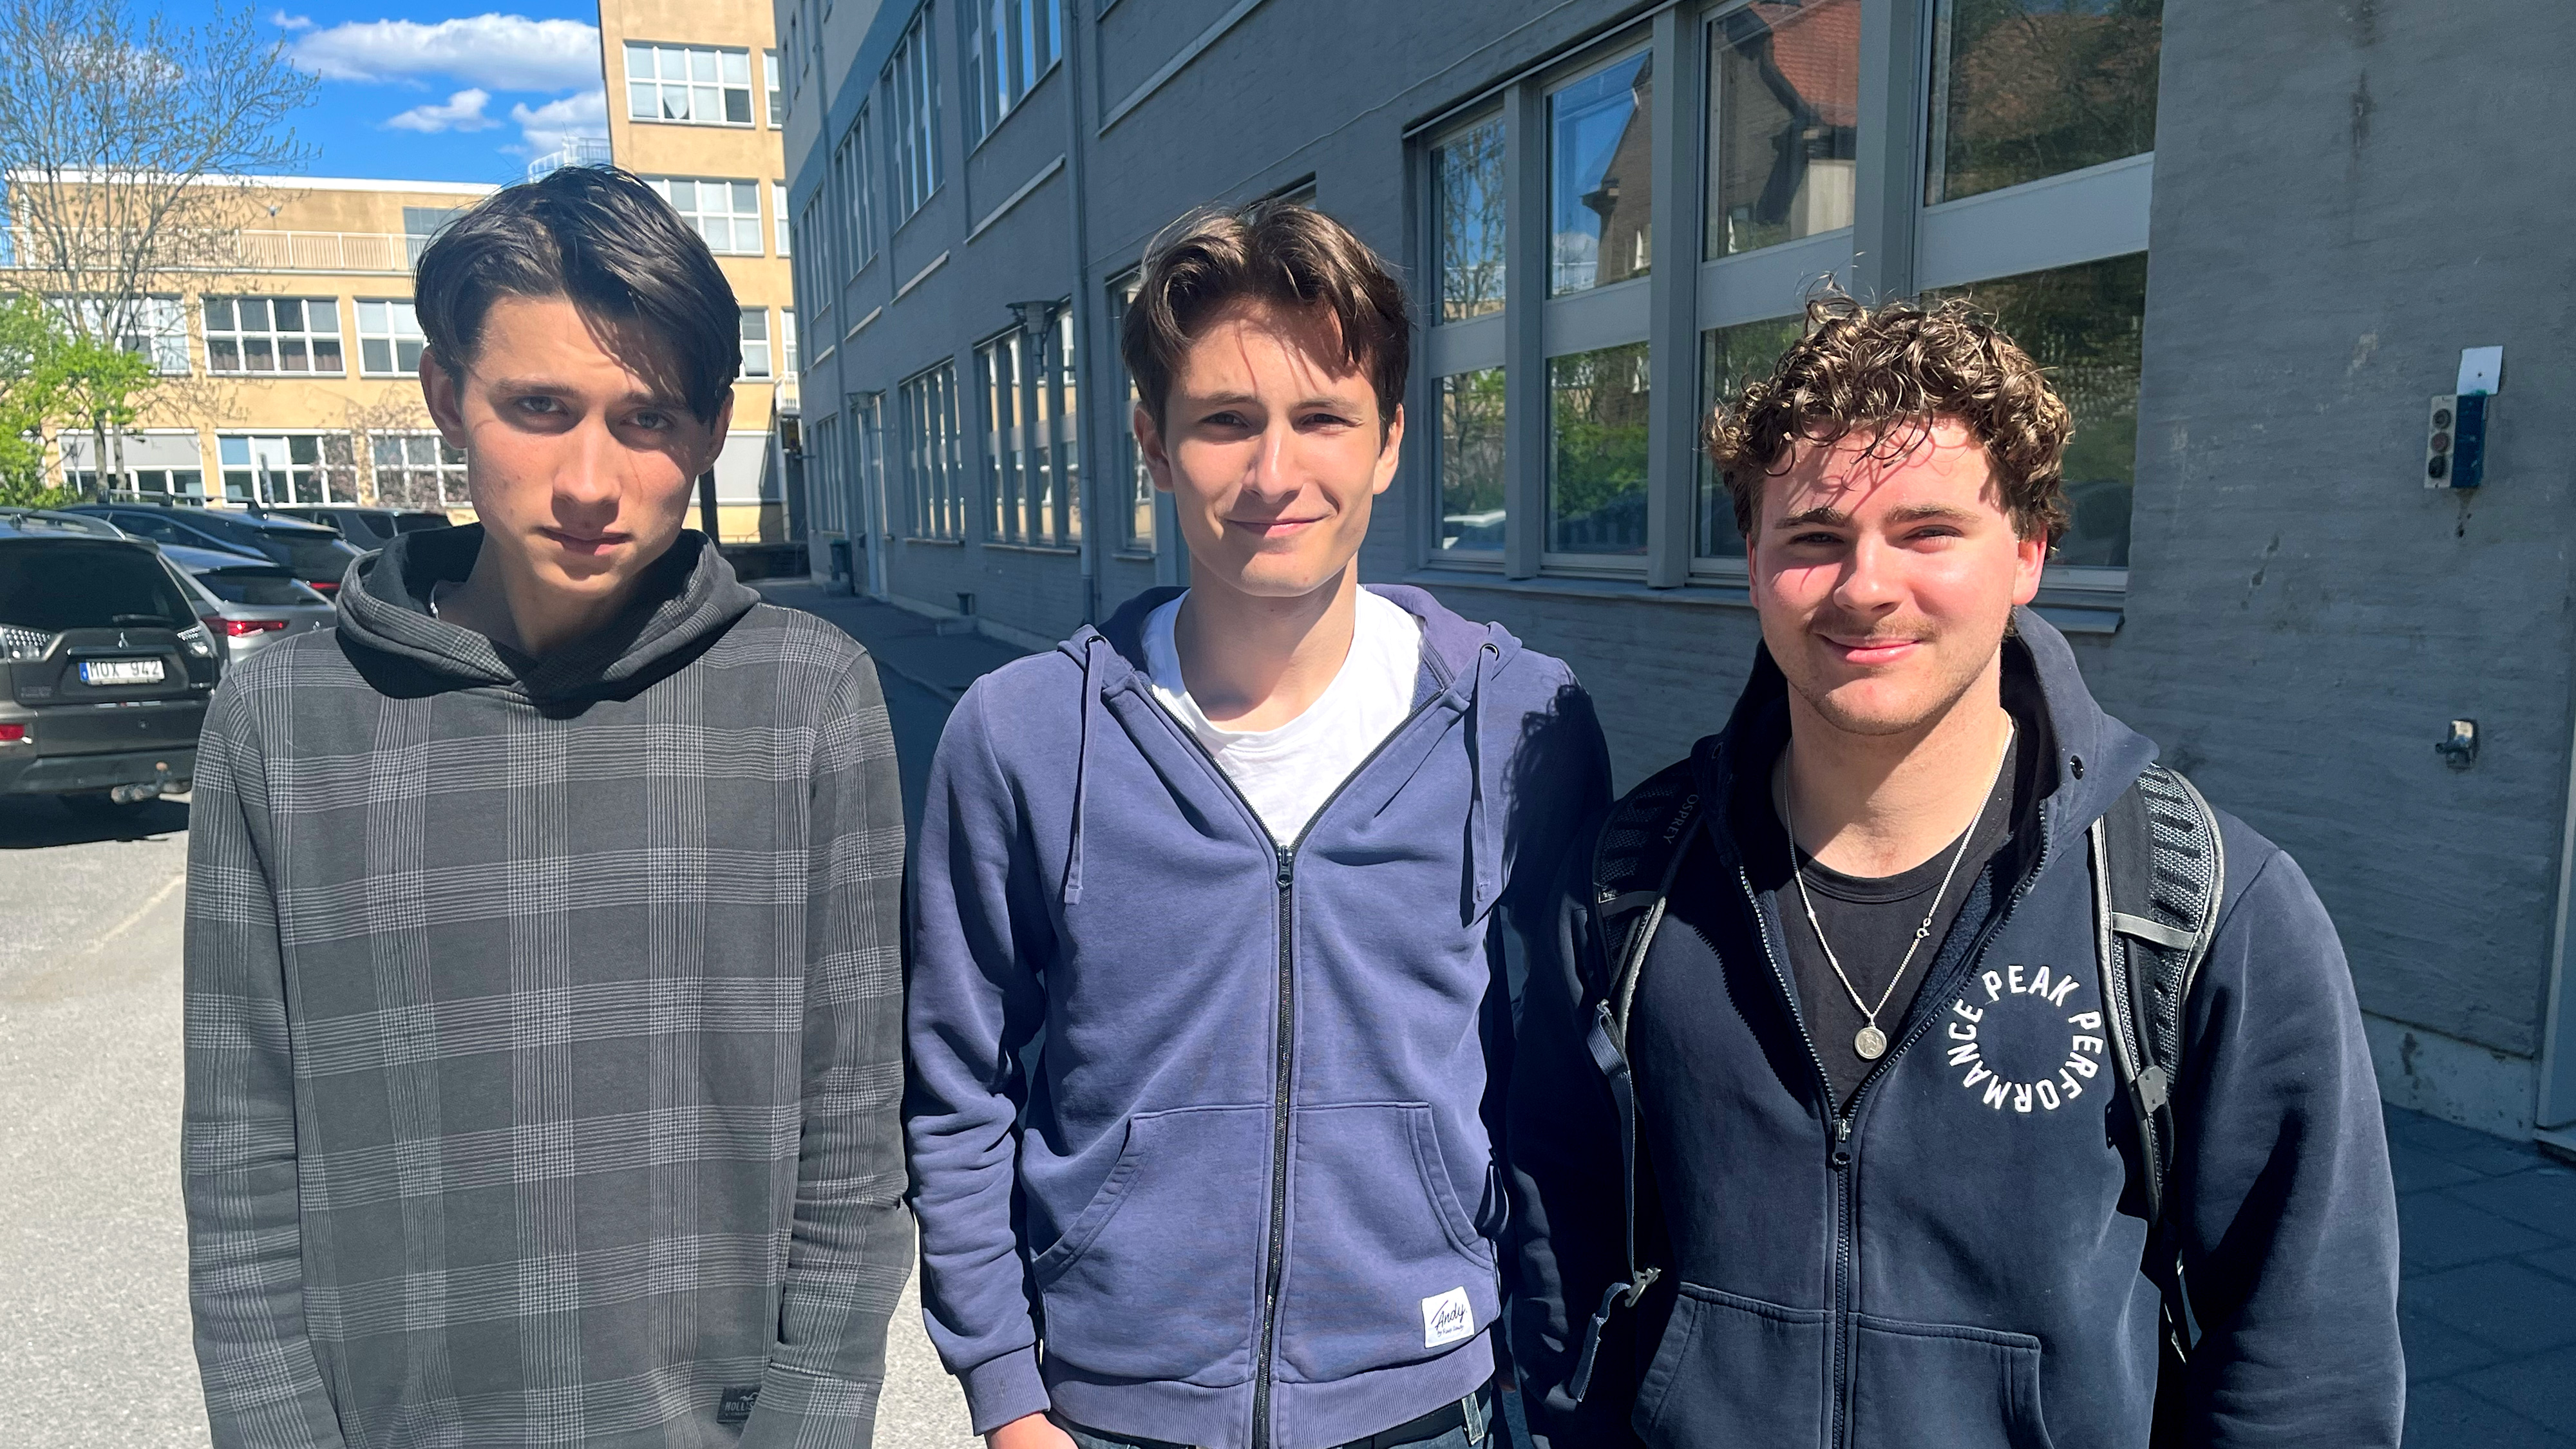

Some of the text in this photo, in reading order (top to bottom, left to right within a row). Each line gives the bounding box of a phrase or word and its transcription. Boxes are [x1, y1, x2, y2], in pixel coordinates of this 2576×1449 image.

[90, 660, 160, 677] MOX 942
[1663, 794, 1700, 844] OSPREY
[1947, 965, 2103, 1112] PEAK PERFORMANCE
